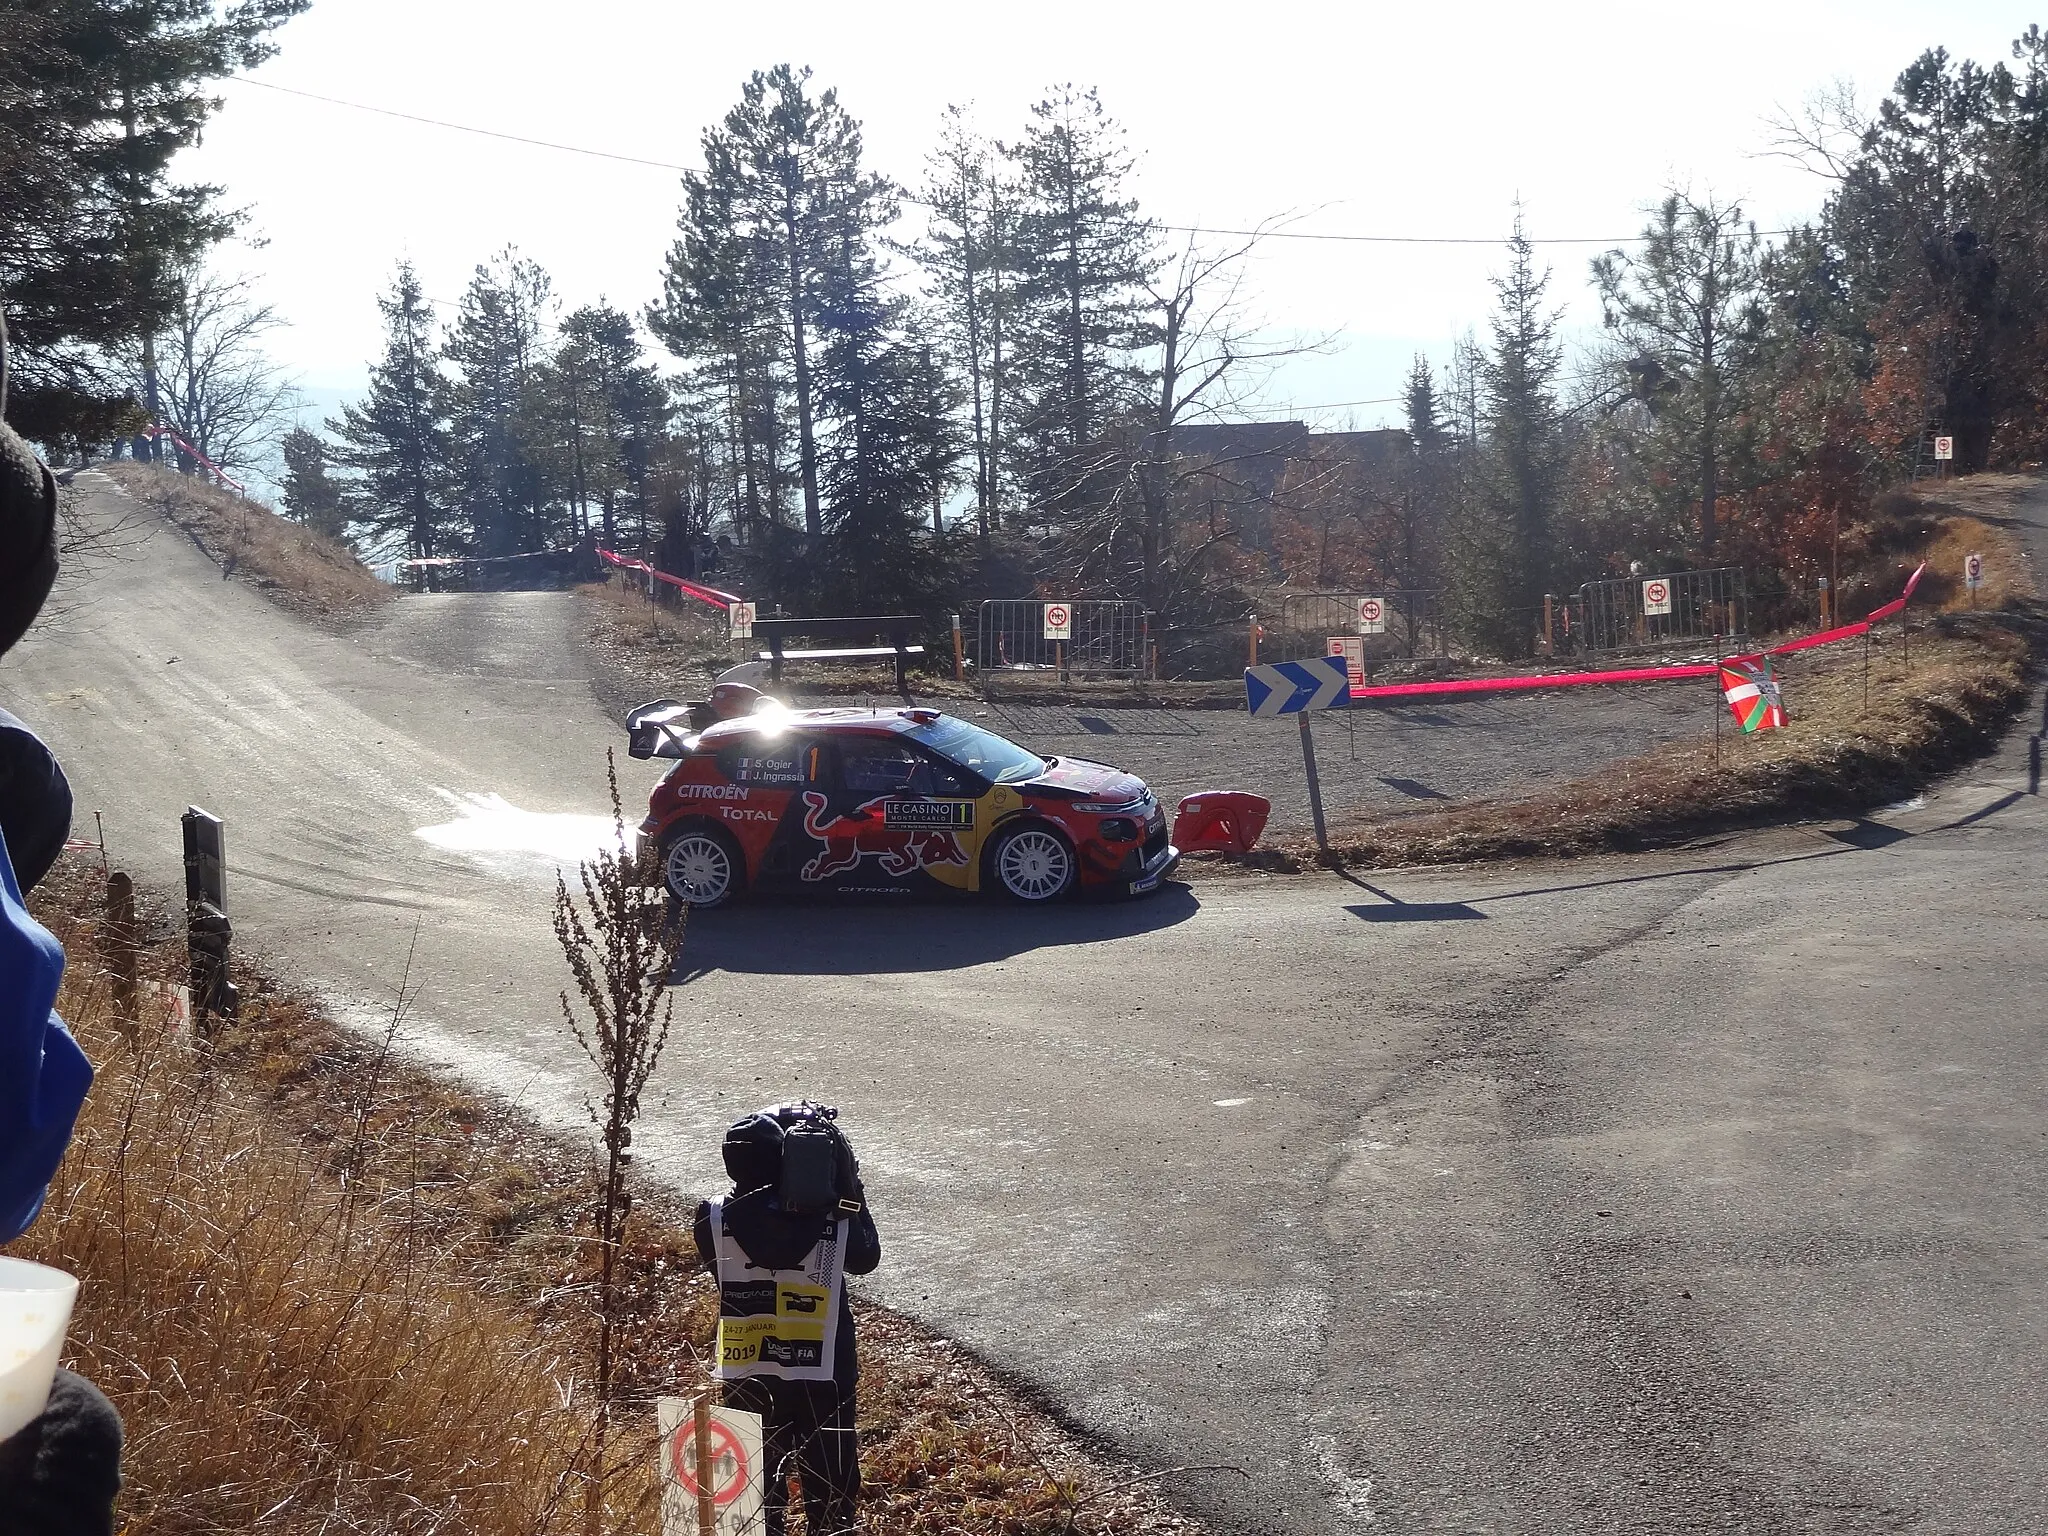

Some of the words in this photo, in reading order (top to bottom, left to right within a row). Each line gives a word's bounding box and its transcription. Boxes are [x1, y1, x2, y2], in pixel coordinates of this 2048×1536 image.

[754, 759, 764, 769] S.
[766, 759, 792, 770] Ogier
[810, 747, 818, 781] 1
[753, 772, 762, 781] J.
[763, 772, 805, 783] Ingrassia
[677, 783, 750, 801] CITROËN
[719, 805, 779, 821] TOTAL
[887, 804, 900, 814] LE
[901, 804, 950, 815] CASINO
[959, 803, 966, 823] 1
[724, 1325, 743, 1334] 24-27
[723, 1344, 756, 1361] 2019
